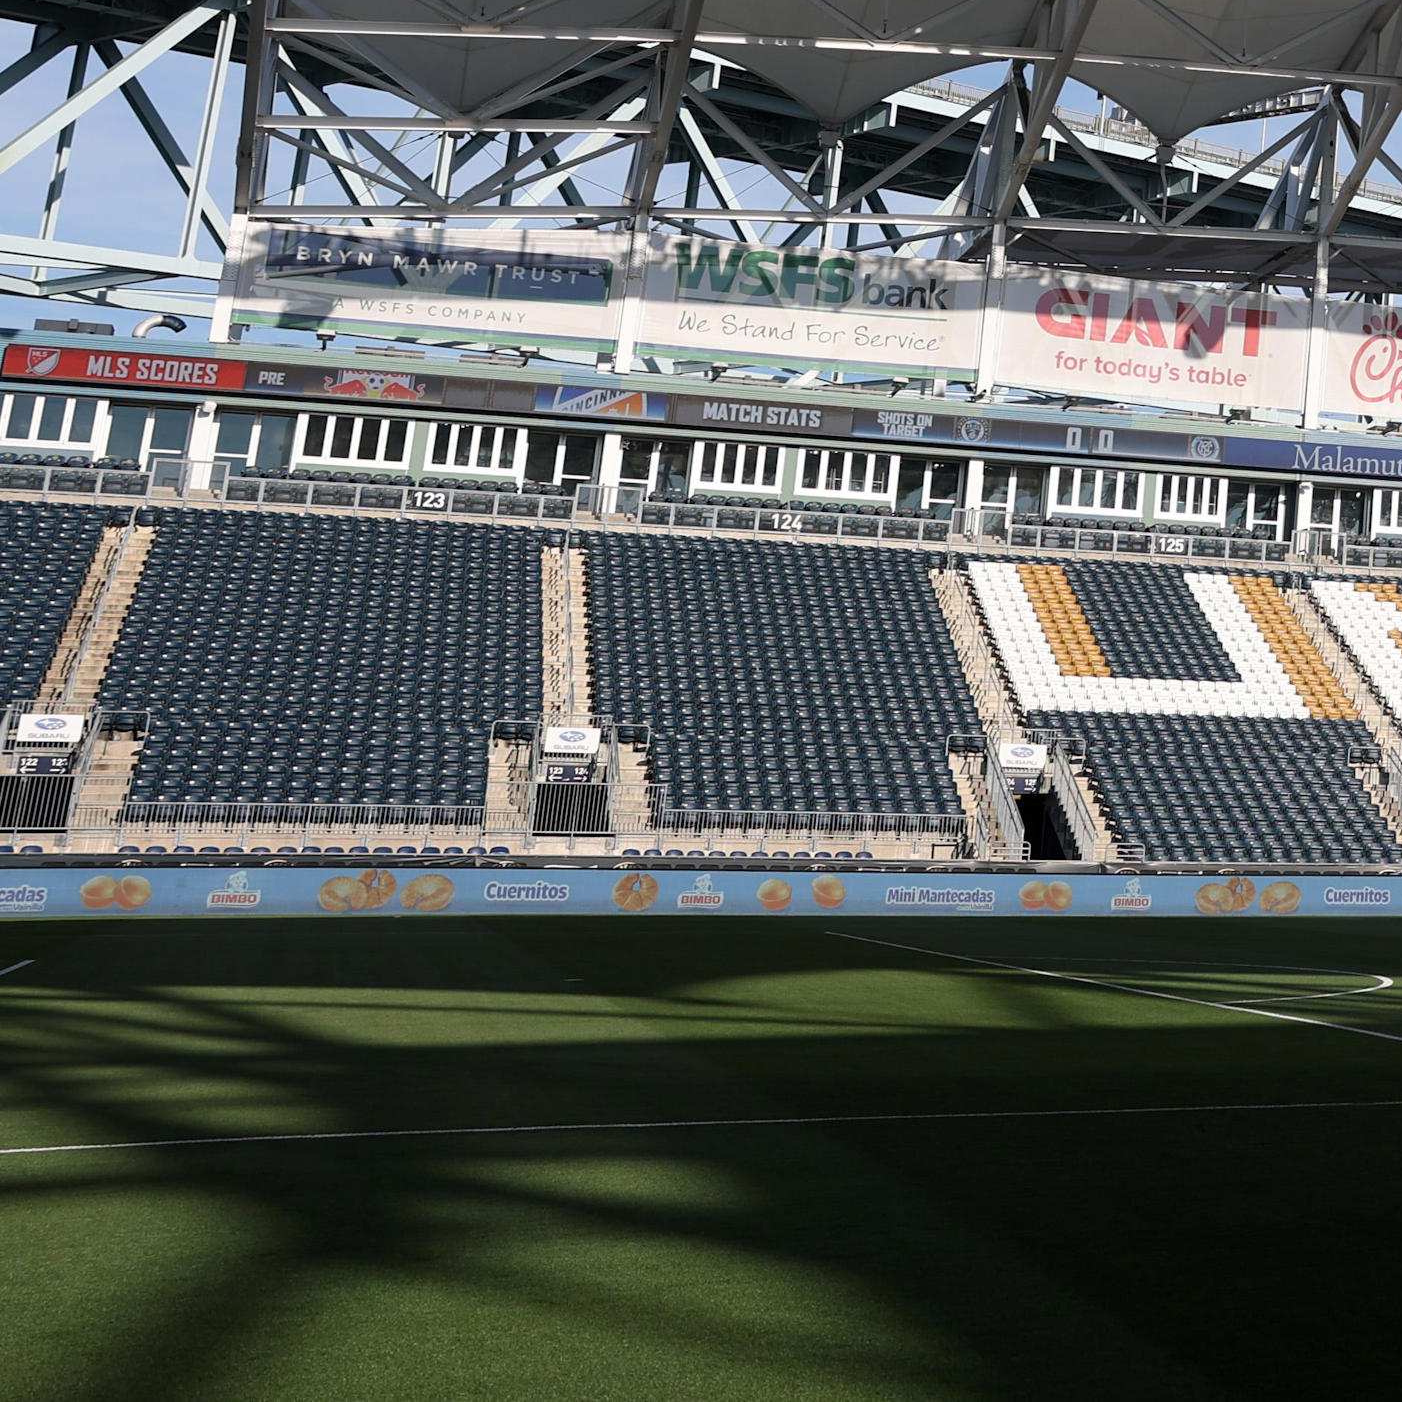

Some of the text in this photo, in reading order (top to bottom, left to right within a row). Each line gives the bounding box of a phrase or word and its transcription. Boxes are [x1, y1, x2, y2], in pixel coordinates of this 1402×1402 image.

[296, 245, 580, 286] BRYN MAWR TRUST
[676, 242, 949, 310] WSFS bank
[335, 297, 528, 323] A WSFS COMPANY
[1035, 288, 1277, 357] GIANT
[678, 311, 941, 352] We Stand For Service
[86, 355, 218, 384] MLS SCORES
[258, 370, 286, 386] PRE
[1054, 351, 1247, 388] for today's table
[703, 401, 821, 428] MATCH STATS
[877, 411, 933, 427] SHOTS ON
[882, 423, 925, 437] TARGET
[1065, 427, 1114, 451] 0 0
[413, 491, 446, 510] 123
[771, 514, 802, 531] 124
[1158, 537, 1185, 553] 125
[20, 758, 38, 766] 122
[210, 893, 258, 904] BIMBO
[485, 882, 568, 900] Cuernitos
[680, 894, 721, 905] BIMBO
[887, 888, 994, 903] Mini Mantecadas
[1325, 887, 1389, 903] Cuernitos
[1113, 898, 1149, 907] BIMBO
